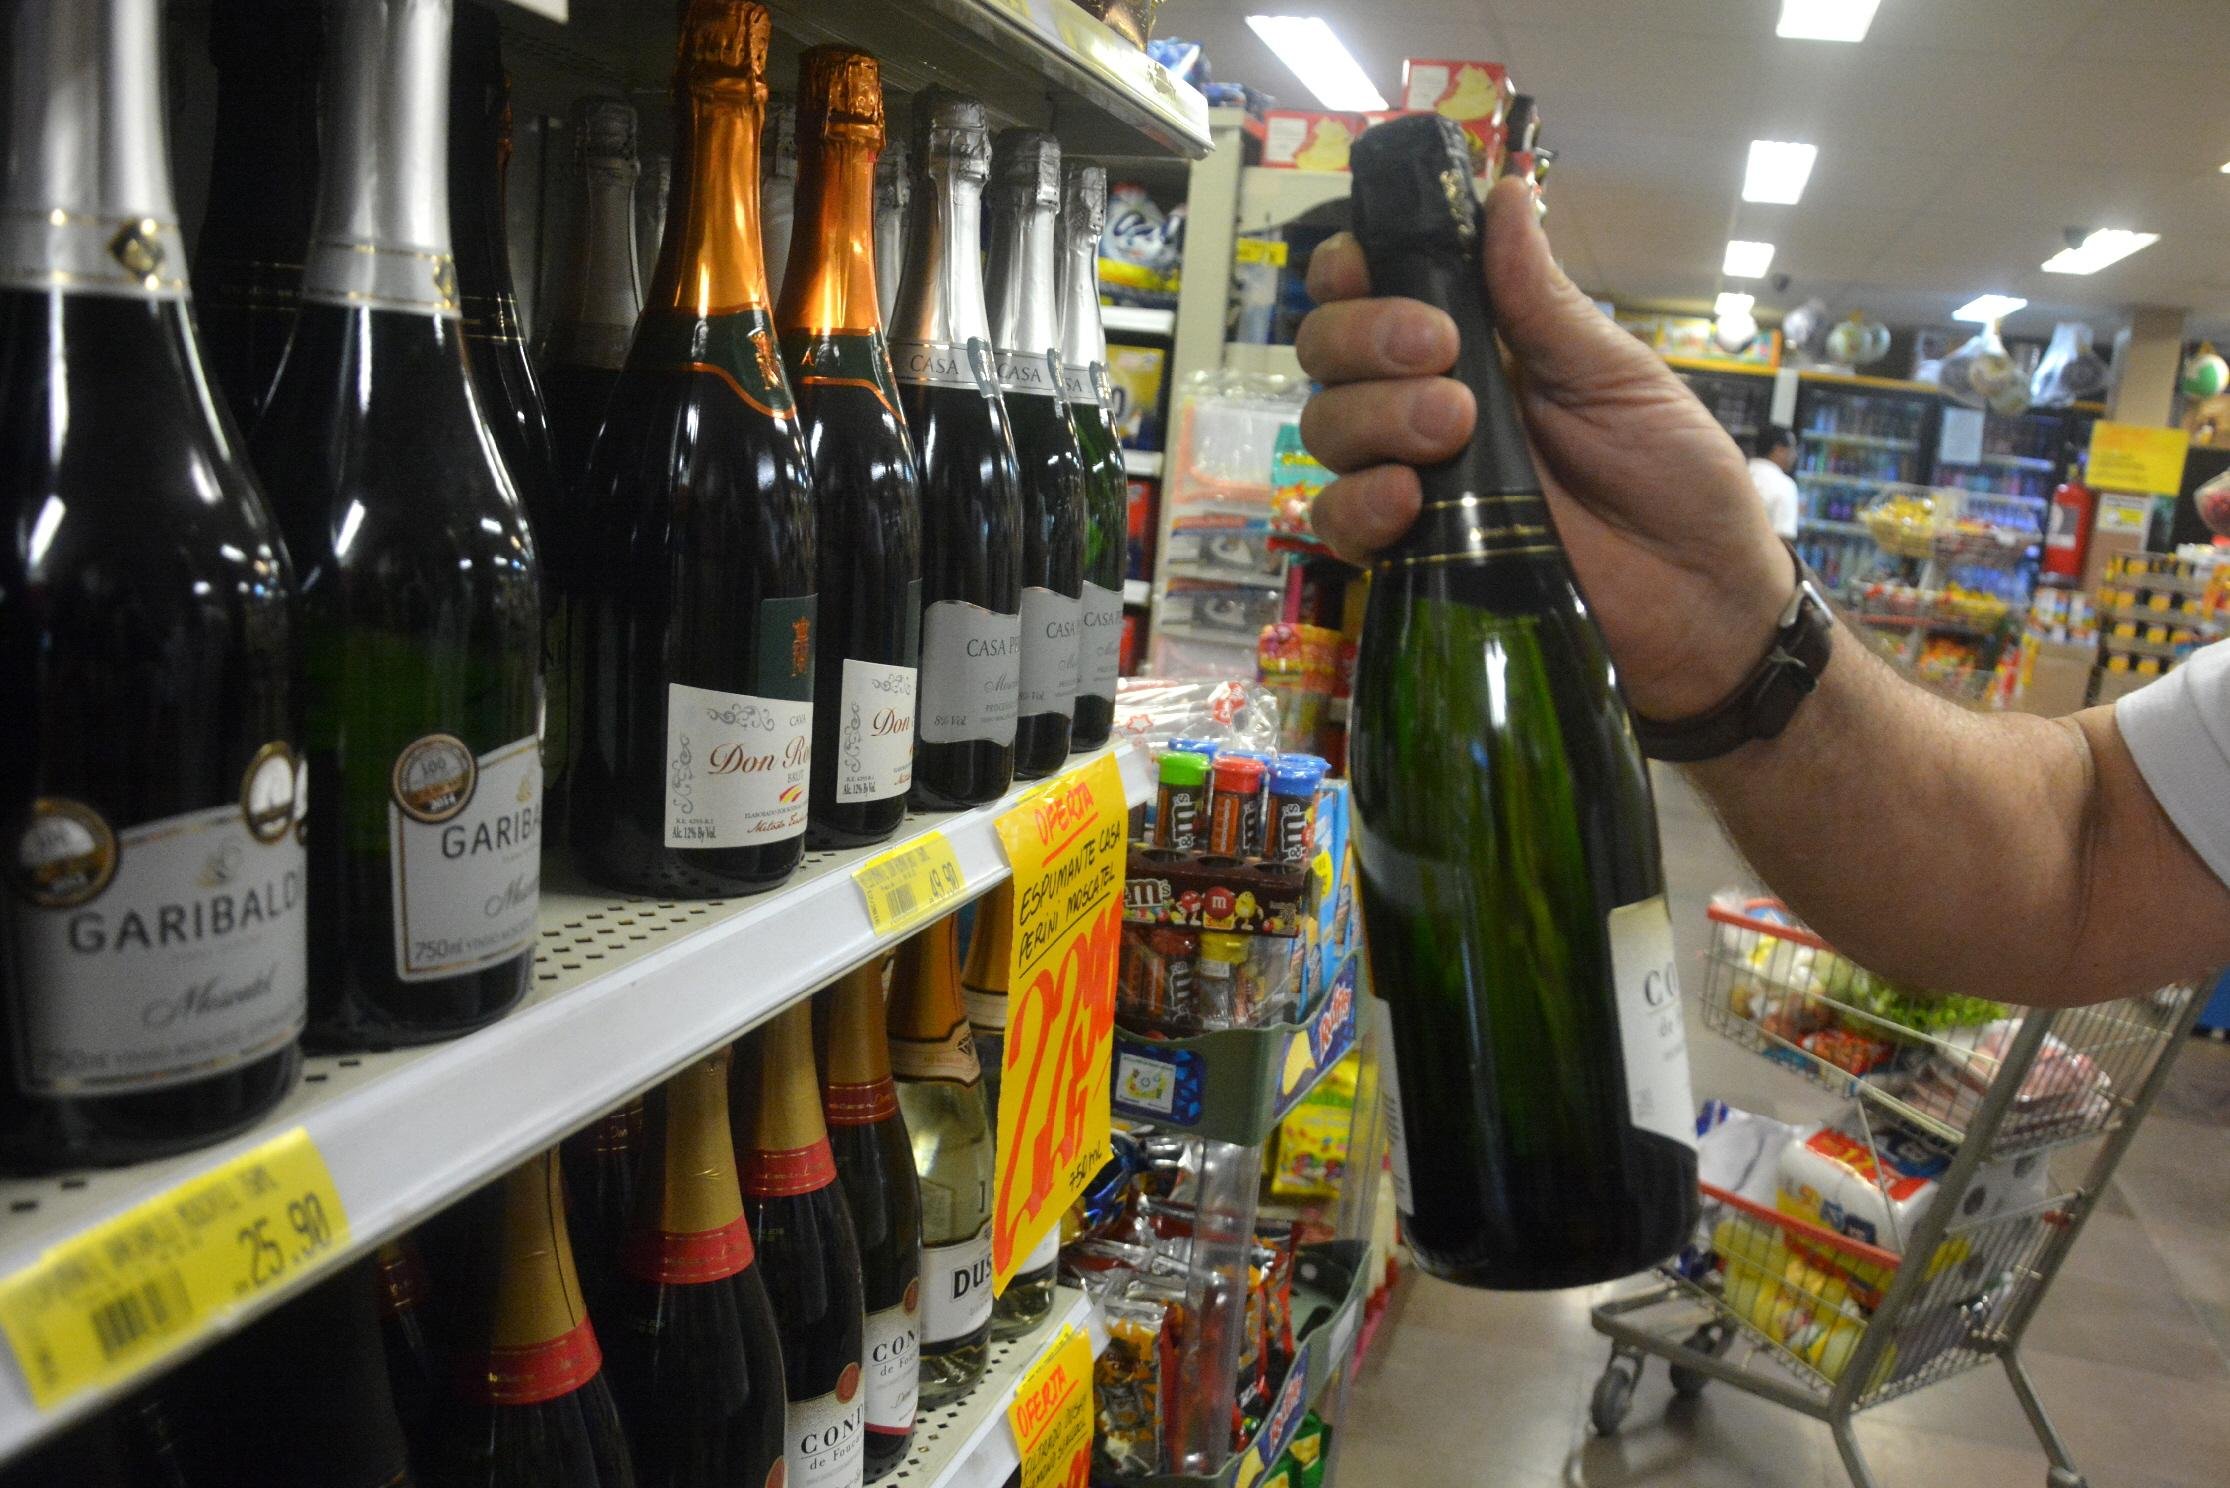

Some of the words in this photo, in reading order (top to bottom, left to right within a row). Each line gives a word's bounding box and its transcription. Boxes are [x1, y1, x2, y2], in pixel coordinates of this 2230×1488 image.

[910, 353, 959, 376] CASA
[997, 361, 1042, 384] CASA
[1064, 376, 1083, 393] SA
[966, 638, 1005, 658] CASA
[870, 707, 911, 737] Don
[708, 742, 776, 775] Don
[1034, 781, 1096, 846] OFERTA
[1020, 836, 1097, 926] ESPUMANTE
[1099, 819, 1121, 853] CASA
[1018, 910, 1060, 968] PERINI
[1065, 862, 1117, 922] MOSCATEL
[880, 1363, 894, 1377] de
[1016, 1364, 1067, 1438] OFERTA
[809, 1457, 826, 1471] de
